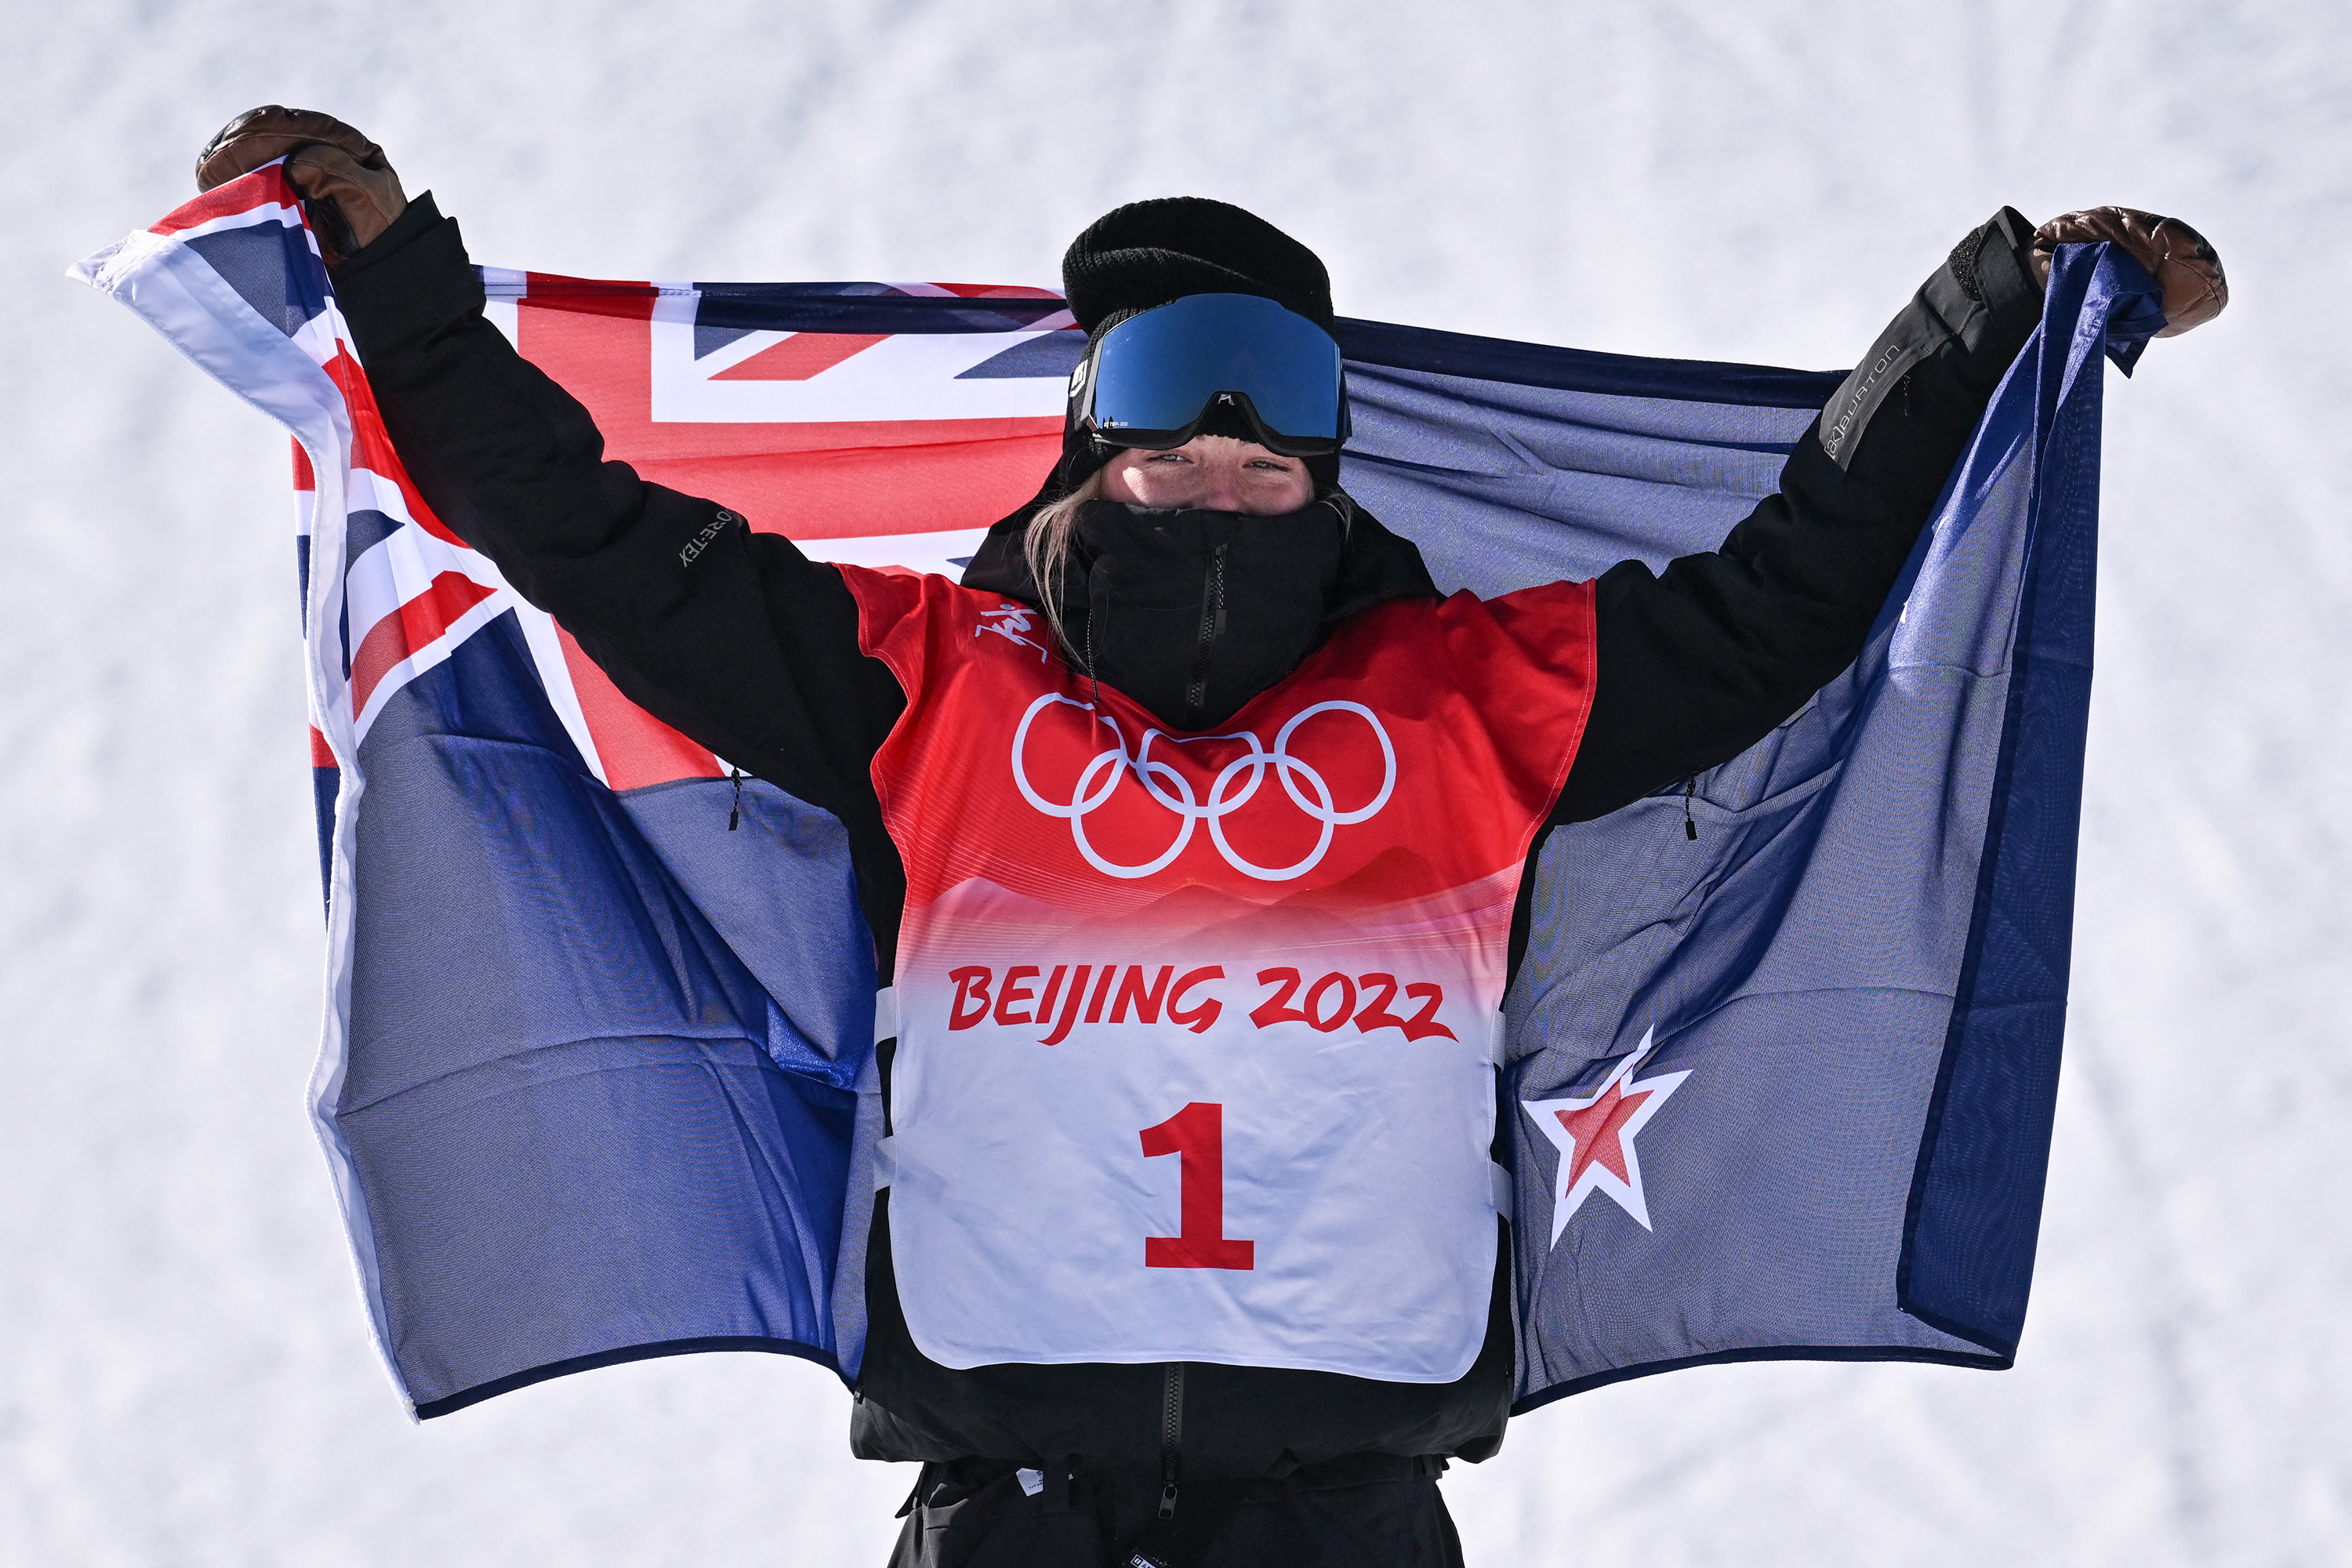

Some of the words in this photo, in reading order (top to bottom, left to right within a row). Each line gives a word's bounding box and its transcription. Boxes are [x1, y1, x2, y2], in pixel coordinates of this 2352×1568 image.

[948, 964, 1225, 1047] BEIJING
[1249, 967, 1460, 1043] 2022
[1139, 1102, 1254, 1271] 1
